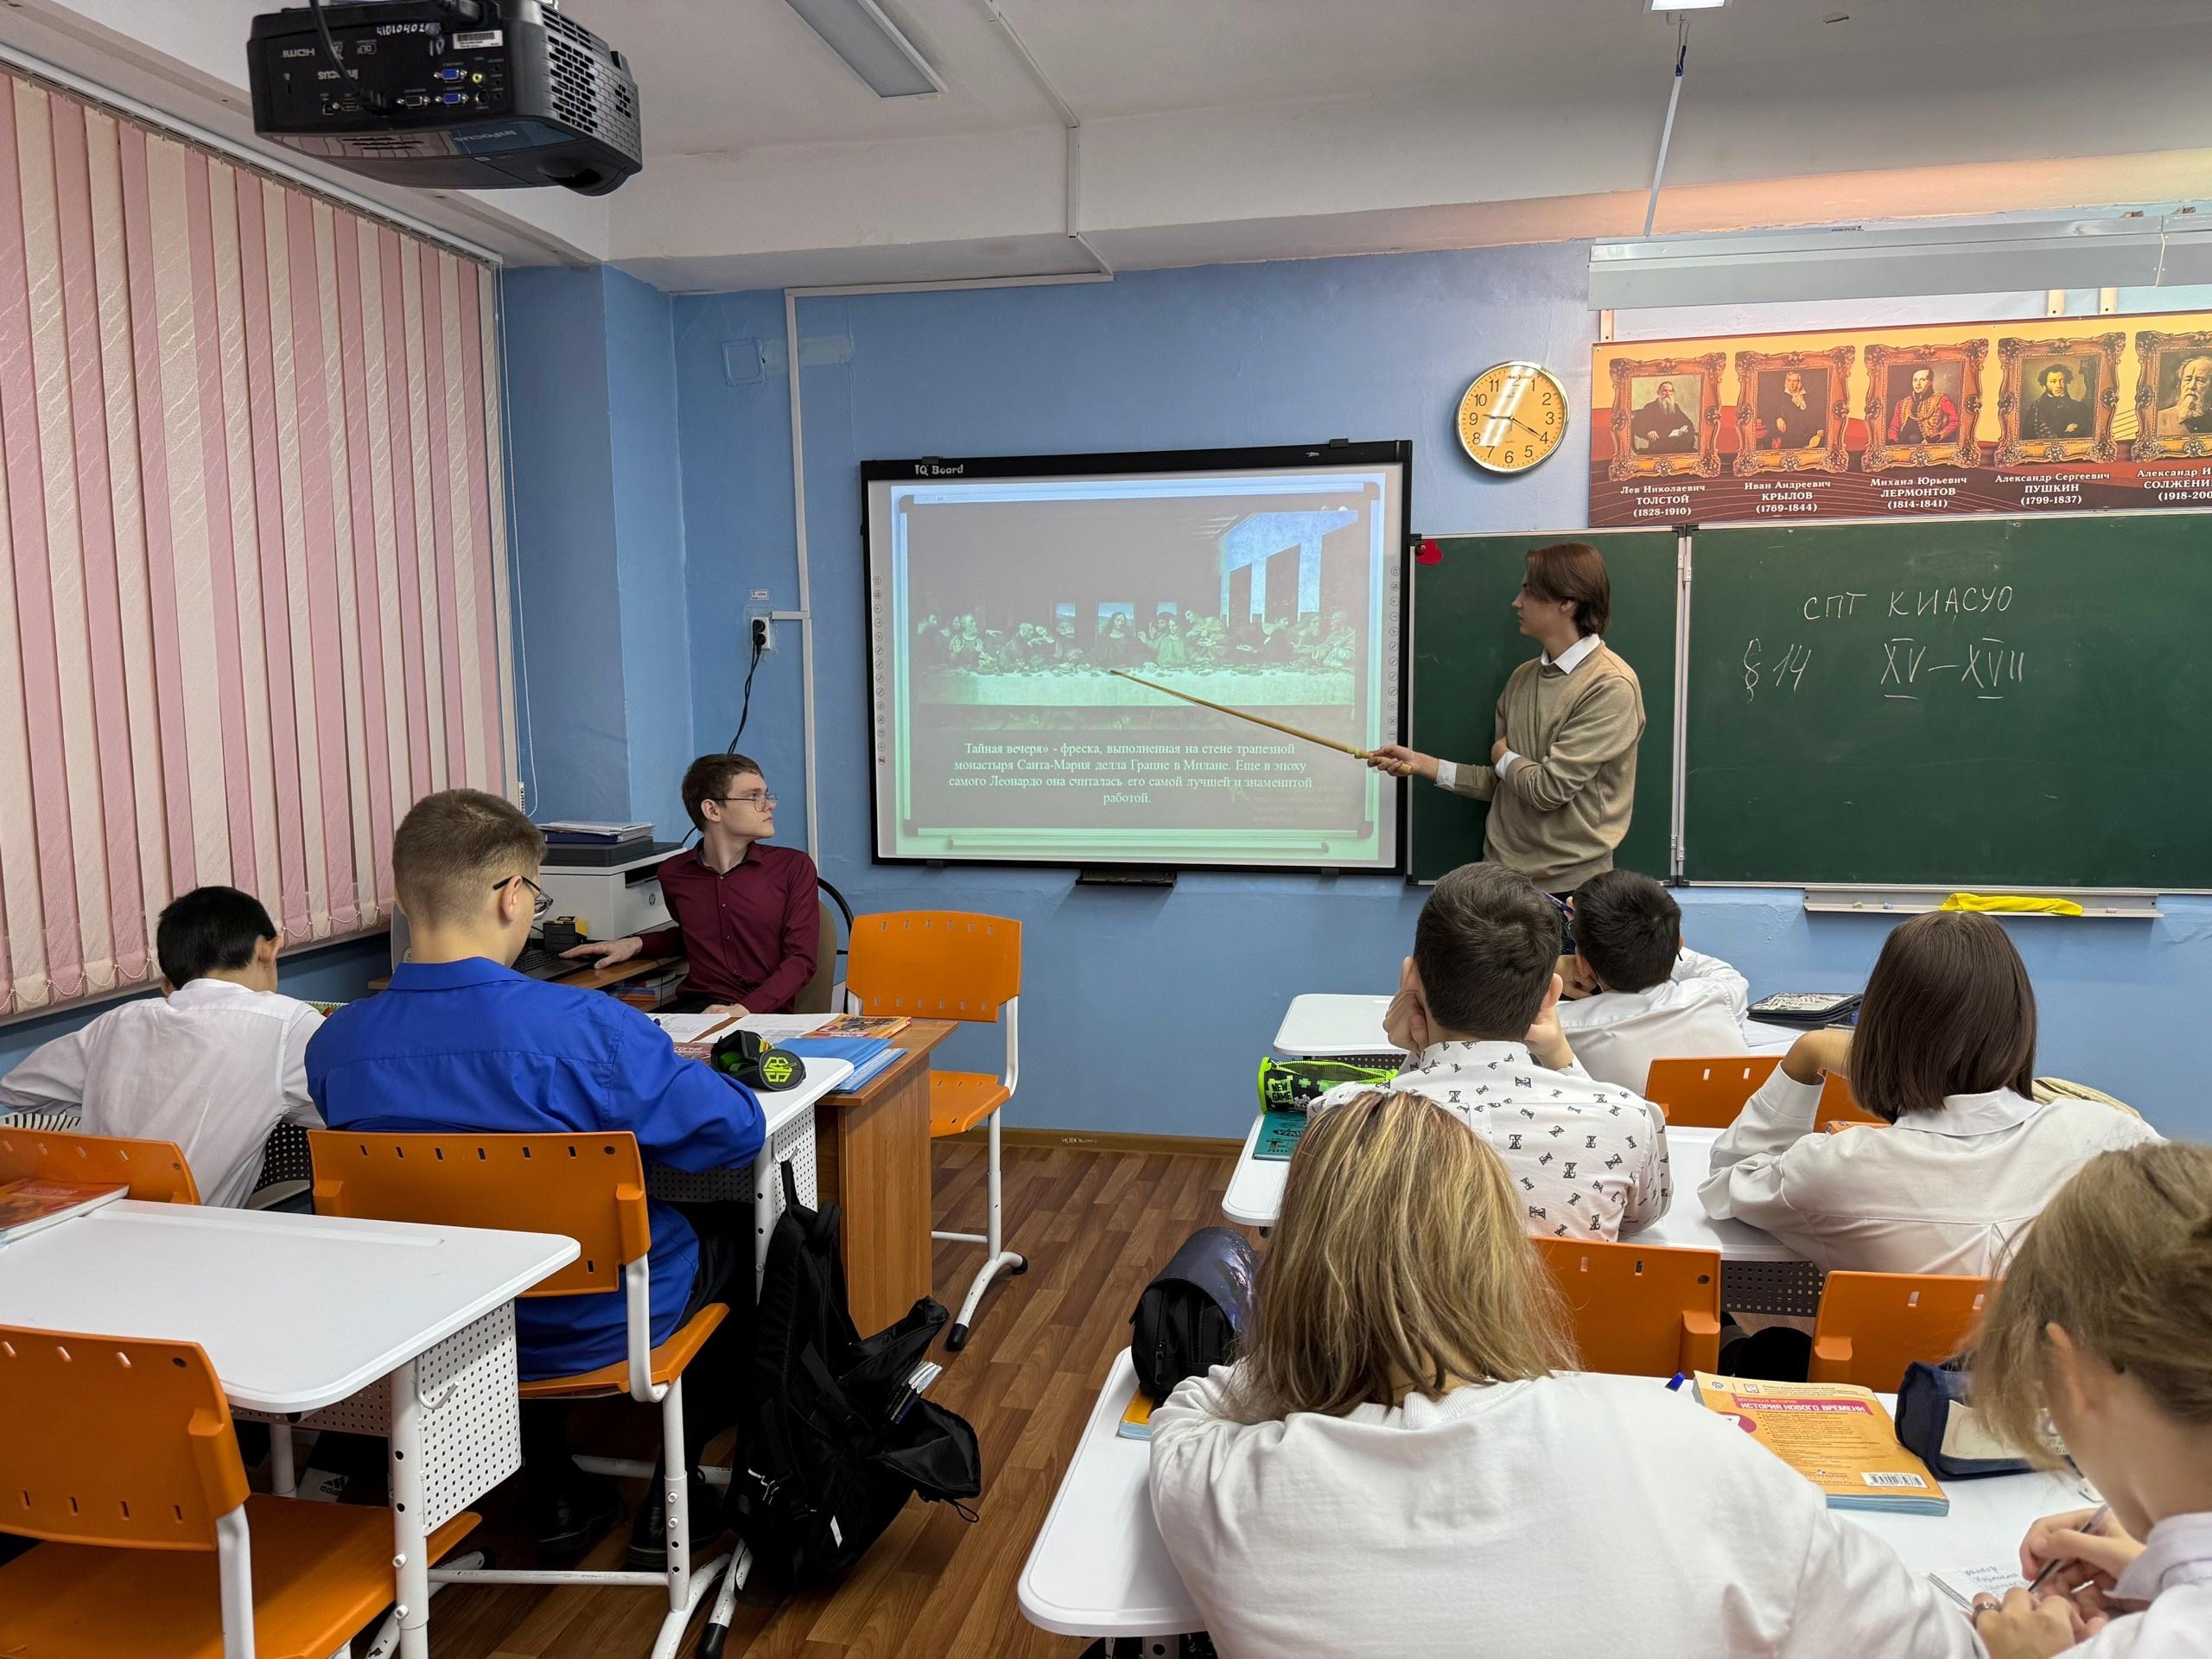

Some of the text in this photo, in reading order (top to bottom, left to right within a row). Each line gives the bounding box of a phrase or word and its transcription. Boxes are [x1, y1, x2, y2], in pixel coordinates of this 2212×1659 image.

[283, 48, 315, 58] HDMI
[317, 69, 359, 80] Incus
[1489, 379, 1500, 392] 11
[1530, 378, 1535, 391] 1
[1474, 393, 1488, 407] 10
[1541, 392, 1552, 406] 2
[1469, 412, 1478, 426] 9
[1545, 411, 1554, 425] 3
[1471, 432, 1481, 445] 8
[1539, 431, 1549, 445] 4
[1486, 445, 1496, 459] 7
[1504, 450, 1514, 464] 6
[1524, 445, 1534, 458] 5
[931, 464, 964, 475] Board
[2137, 469, 2198, 478] Александр
[1870, 475, 1967, 486] Михаил Юрьевич
[1995, 472, 2110, 484] Александр Сергеевич
[2144, 479, 2212, 489] СОЛЖЕНИ
[1620, 484, 1706, 494] Лев Николаевич
[1745, 480, 1831, 491] Иван Андреевич
[2024, 483, 2079, 493] ПУШКИН
[1762, 492, 1813, 501] КРЫЛОВ
[1880, 486, 1956, 499] ЛЕРМОНТОВ
[1636, 494, 1689, 505] ТОЛСТОЙ
[1887, 499, 1948, 510] (1814-1841)
[2020, 494, 2082, 506] (1799-1837)
[1633, 506, 1691, 518] (1828-1910)
[1756, 502, 1818, 514] (1769-1844)
[1803, 591, 1866, 620] СПТ
[1772, 643, 1811, 692] 14
[964, 743, 1003, 754] Тайная
[1007, 745, 1049, 756] вечеря»
[1060, 743, 1103, 756] фреска,
[1107, 745, 1181, 754] выполненная
[1185, 745, 1198, 754] на
[1202, 745, 1232, 754] стене
[1236, 743, 1295, 755] трапезной
[954, 760, 1306, 773] монастыря Санта-Мария делла Грацие в Милане. Еще в эпоху
[949, 776, 1313, 790] самого Леонардо она считалась его самой лучшей и знаменитой
[1103, 792, 1151, 805] работой.
[1273, 1083, 1287, 1091] NEW
[1273, 1091, 1292, 1102] GAME
[1740, 1402, 1782, 1410] ИСТОРИЯ
